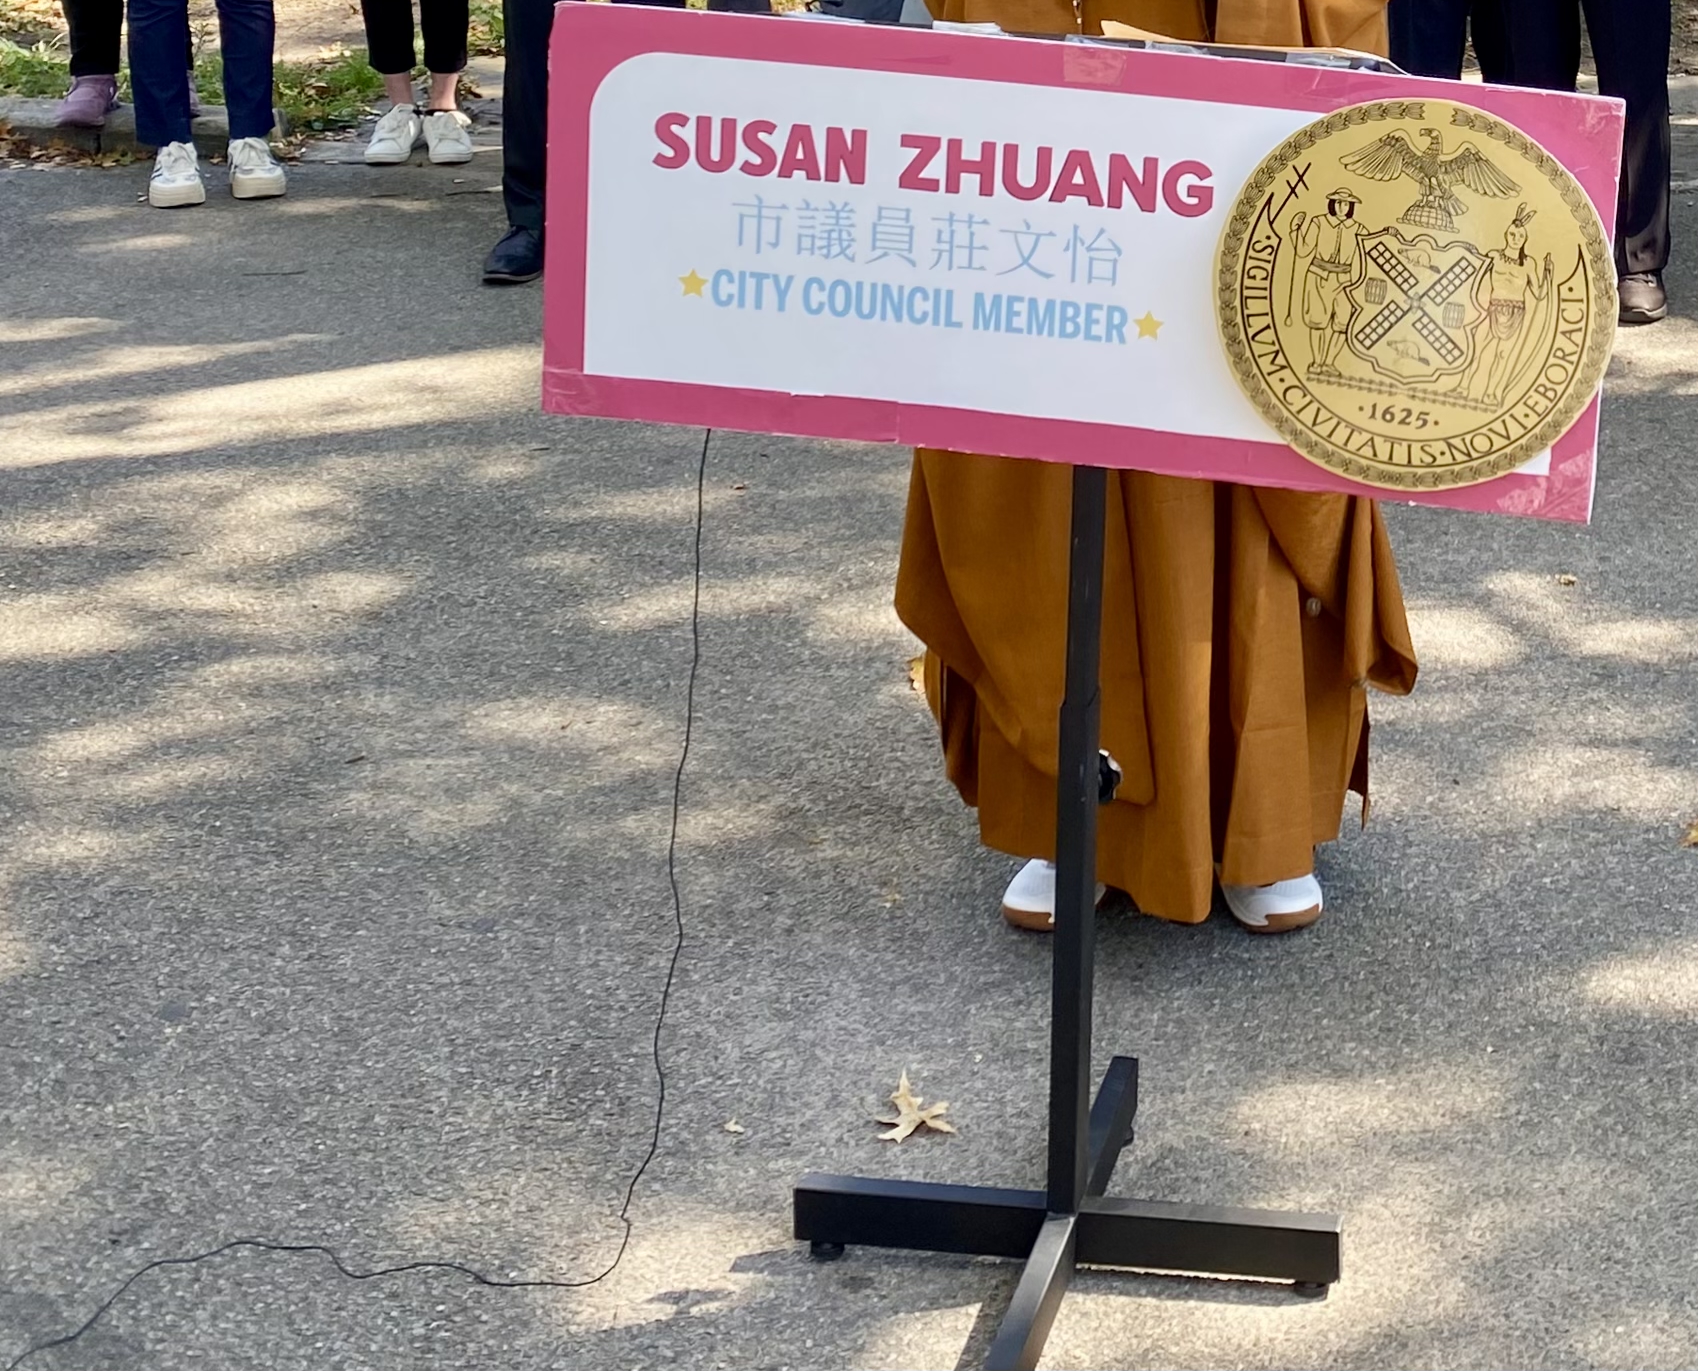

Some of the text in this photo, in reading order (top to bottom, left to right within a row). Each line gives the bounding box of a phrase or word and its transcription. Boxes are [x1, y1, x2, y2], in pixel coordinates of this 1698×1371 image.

[653, 112, 1214, 218] SUSAN ZHUANG
[732, 194, 1123, 287] 市議員莊文怡
[711, 268, 1129, 345] CITY COUNCIL MEMBER
[1244, 239, 1585, 465] SIGILLVM CIVITATIS NOVI EBORACI
[1367, 402, 1431, 430] 1625
